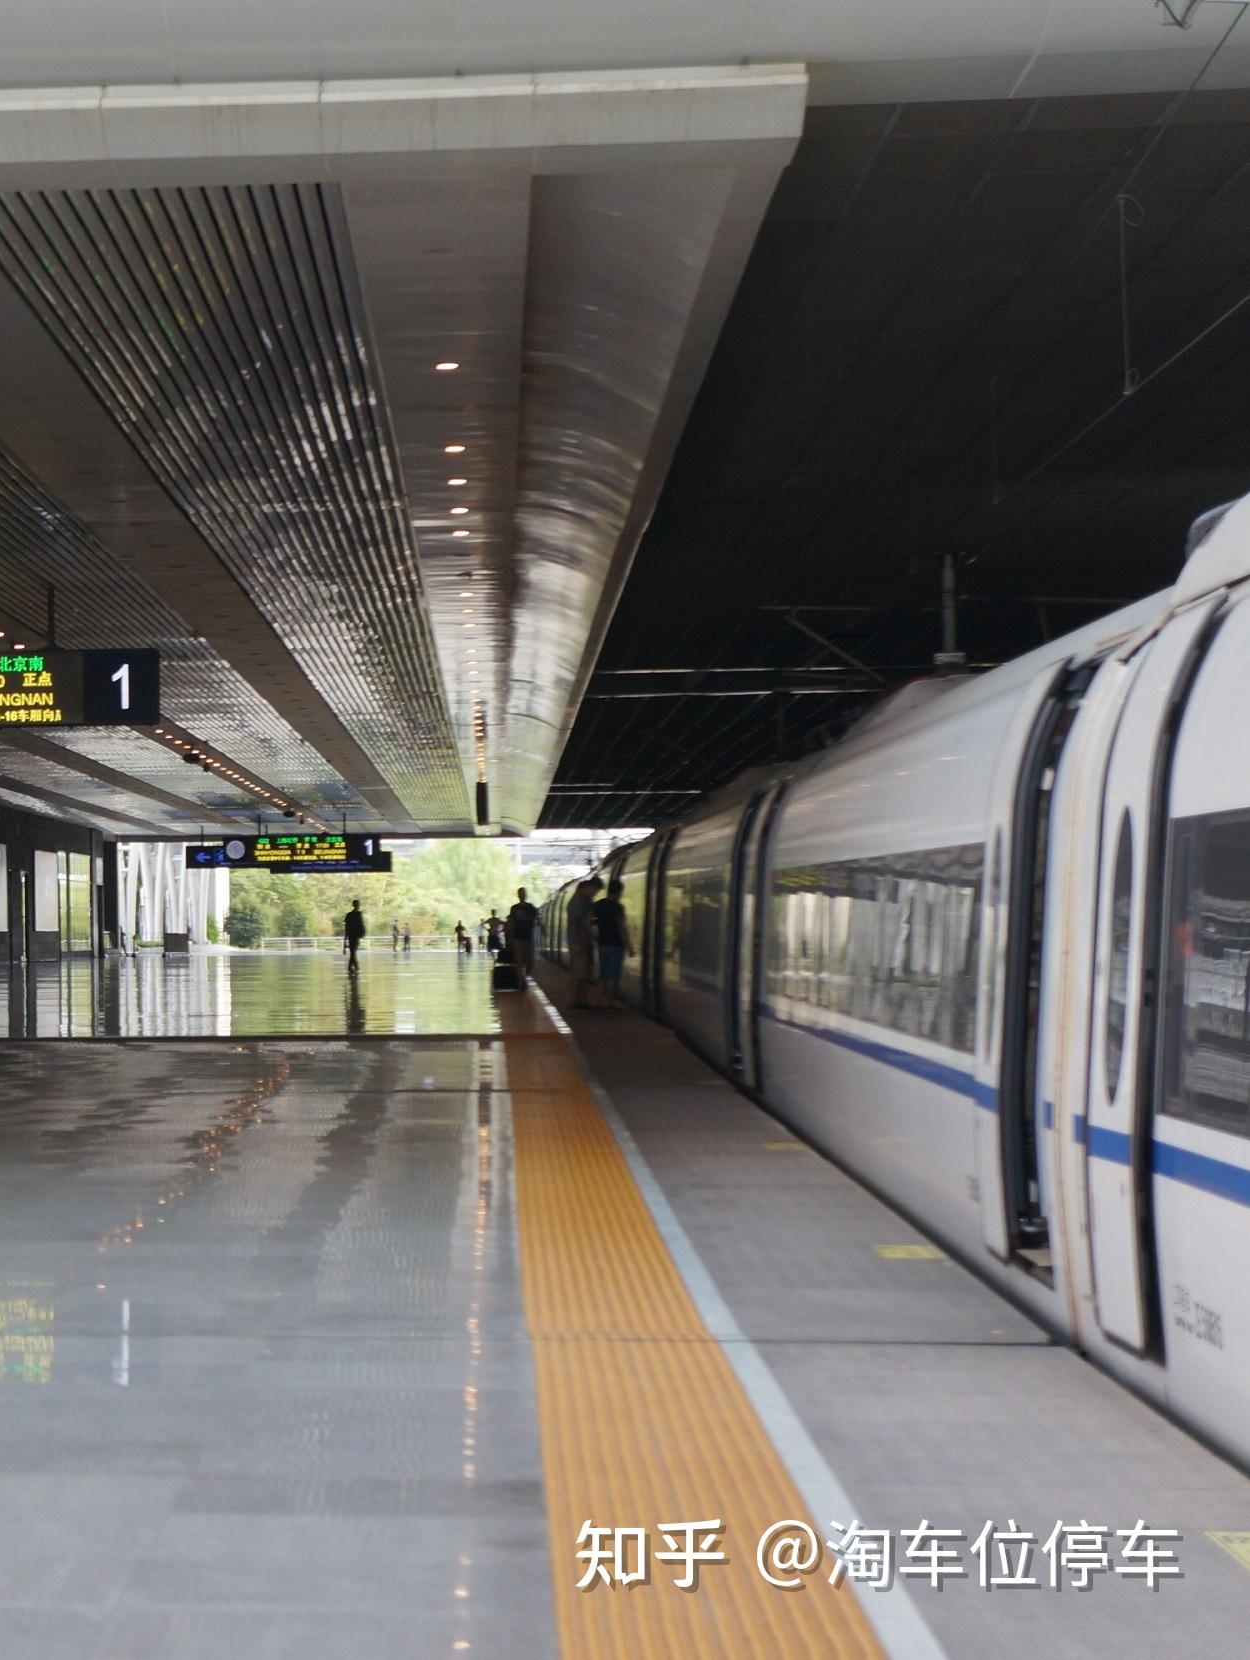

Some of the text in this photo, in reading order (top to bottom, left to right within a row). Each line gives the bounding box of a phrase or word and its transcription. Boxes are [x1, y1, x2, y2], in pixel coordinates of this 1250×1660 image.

[22, 671, 53, 687] 正点
[111, 663, 130, 710] 1
[363, 839, 373, 856] 1
